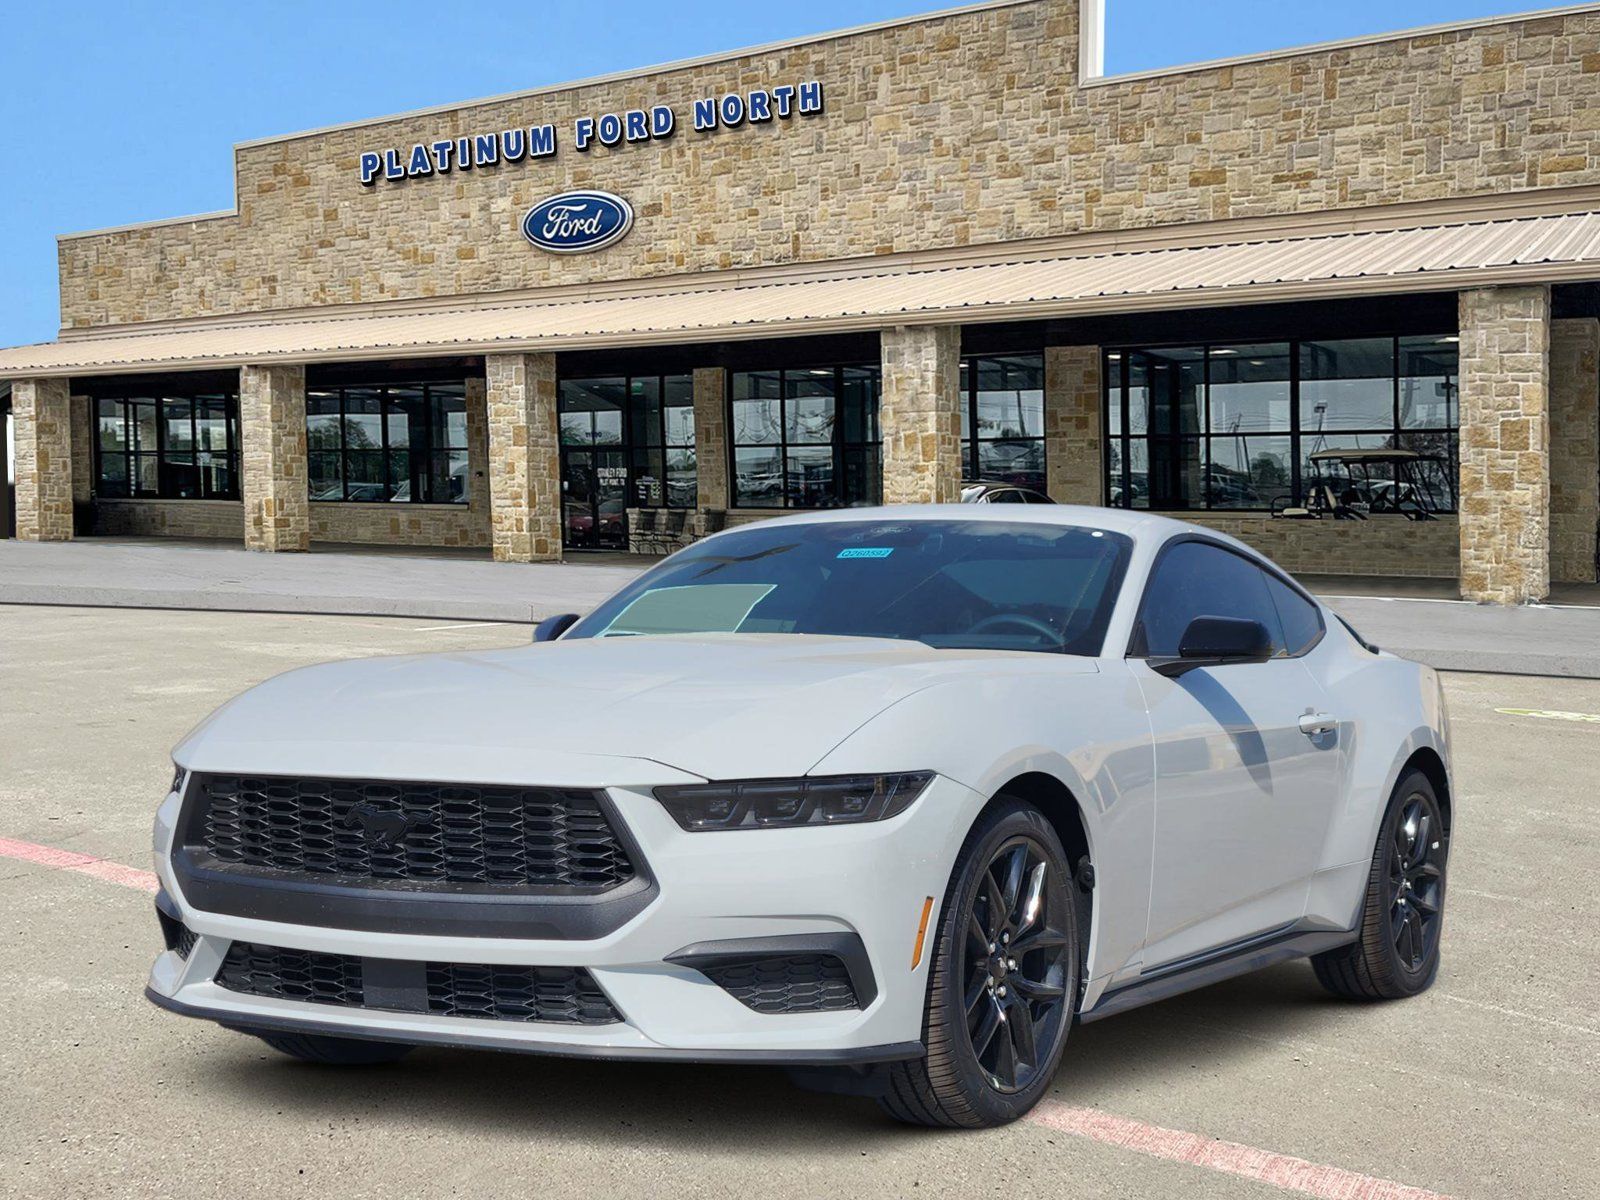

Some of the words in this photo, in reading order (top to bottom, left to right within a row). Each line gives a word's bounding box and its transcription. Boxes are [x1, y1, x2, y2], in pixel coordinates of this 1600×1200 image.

[359, 124, 556, 186] PLATINUM
[575, 106, 675, 150] FORD
[693, 81, 824, 132] NORTH
[541, 203, 602, 240] Ford
